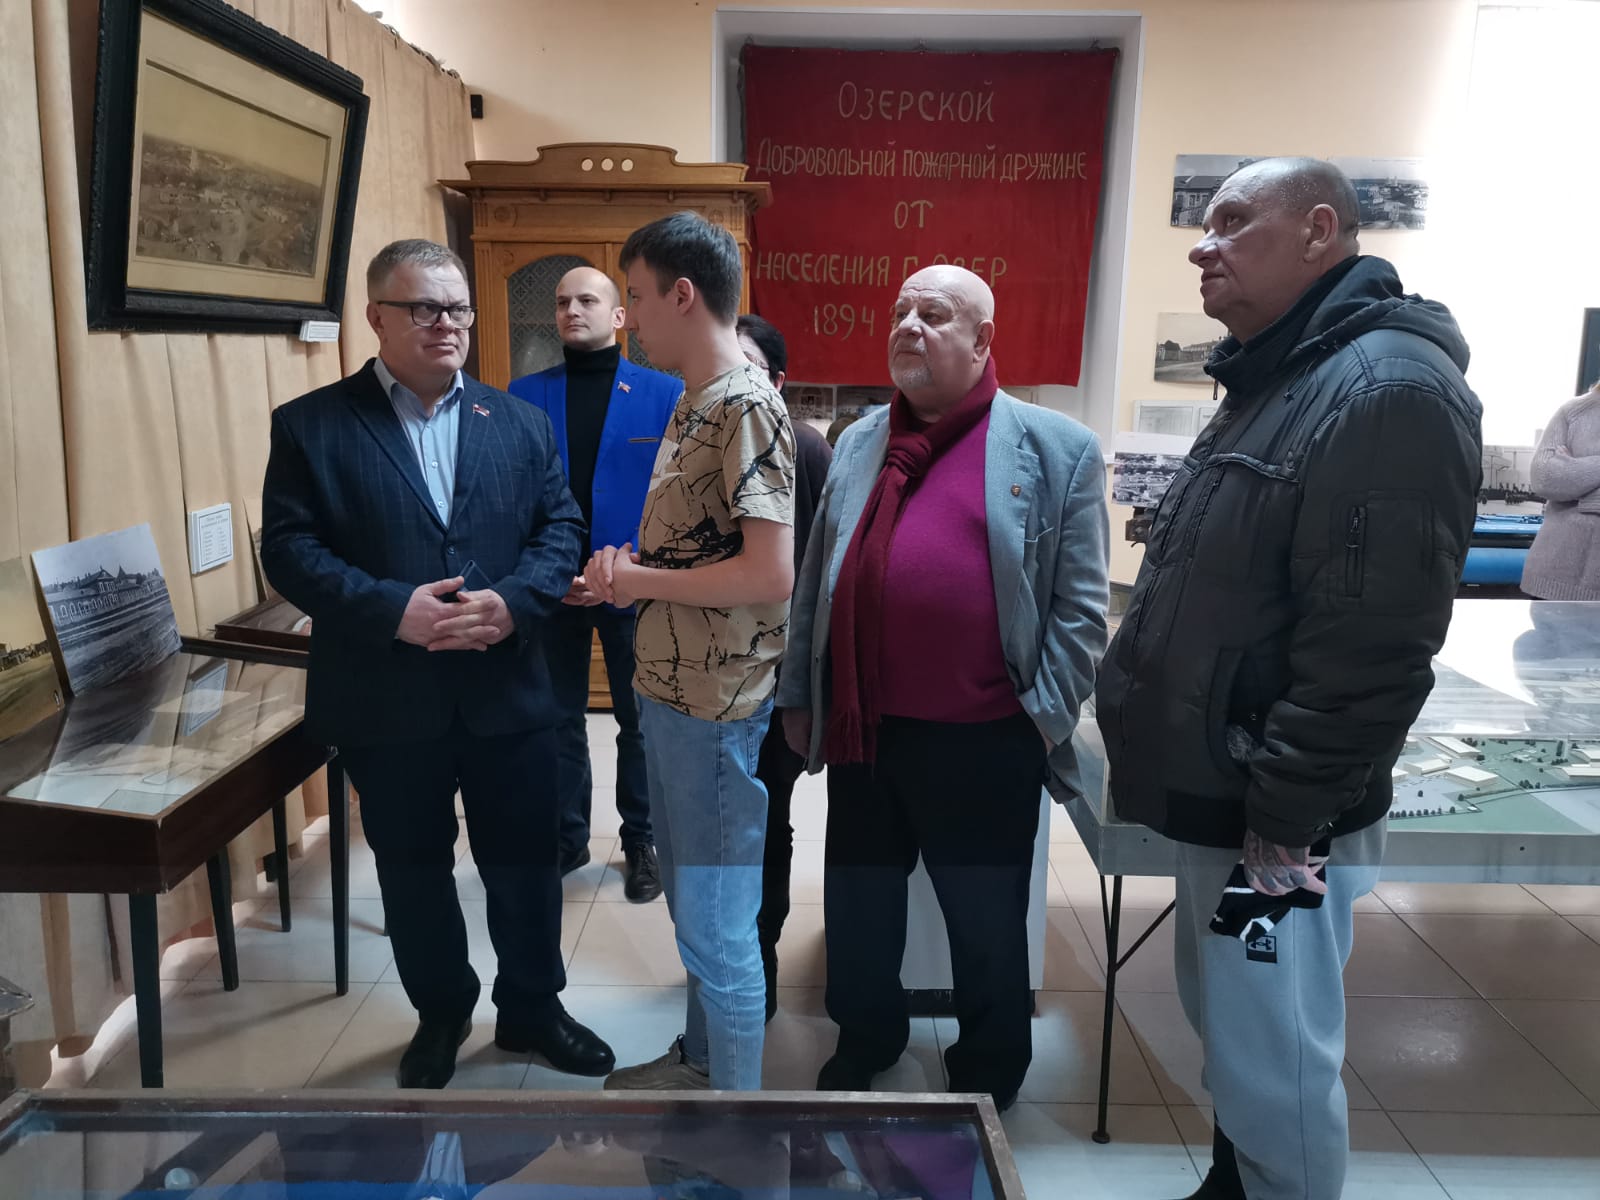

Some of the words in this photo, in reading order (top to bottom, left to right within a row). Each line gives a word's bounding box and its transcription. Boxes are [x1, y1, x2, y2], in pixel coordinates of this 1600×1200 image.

[838, 80, 995, 123] ОЗЕРСКОЙ
[755, 138, 897, 177] ДОБРОВОЛЬНОЙ
[902, 144, 996, 181] ПОЖАРНОЙ
[1000, 151, 1088, 183] ДРУЖИНЕ
[894, 199, 934, 230] ОТ
[756, 250, 890, 287] НАСЕЛЕНИЯ
[814, 303, 876, 341] 1894
